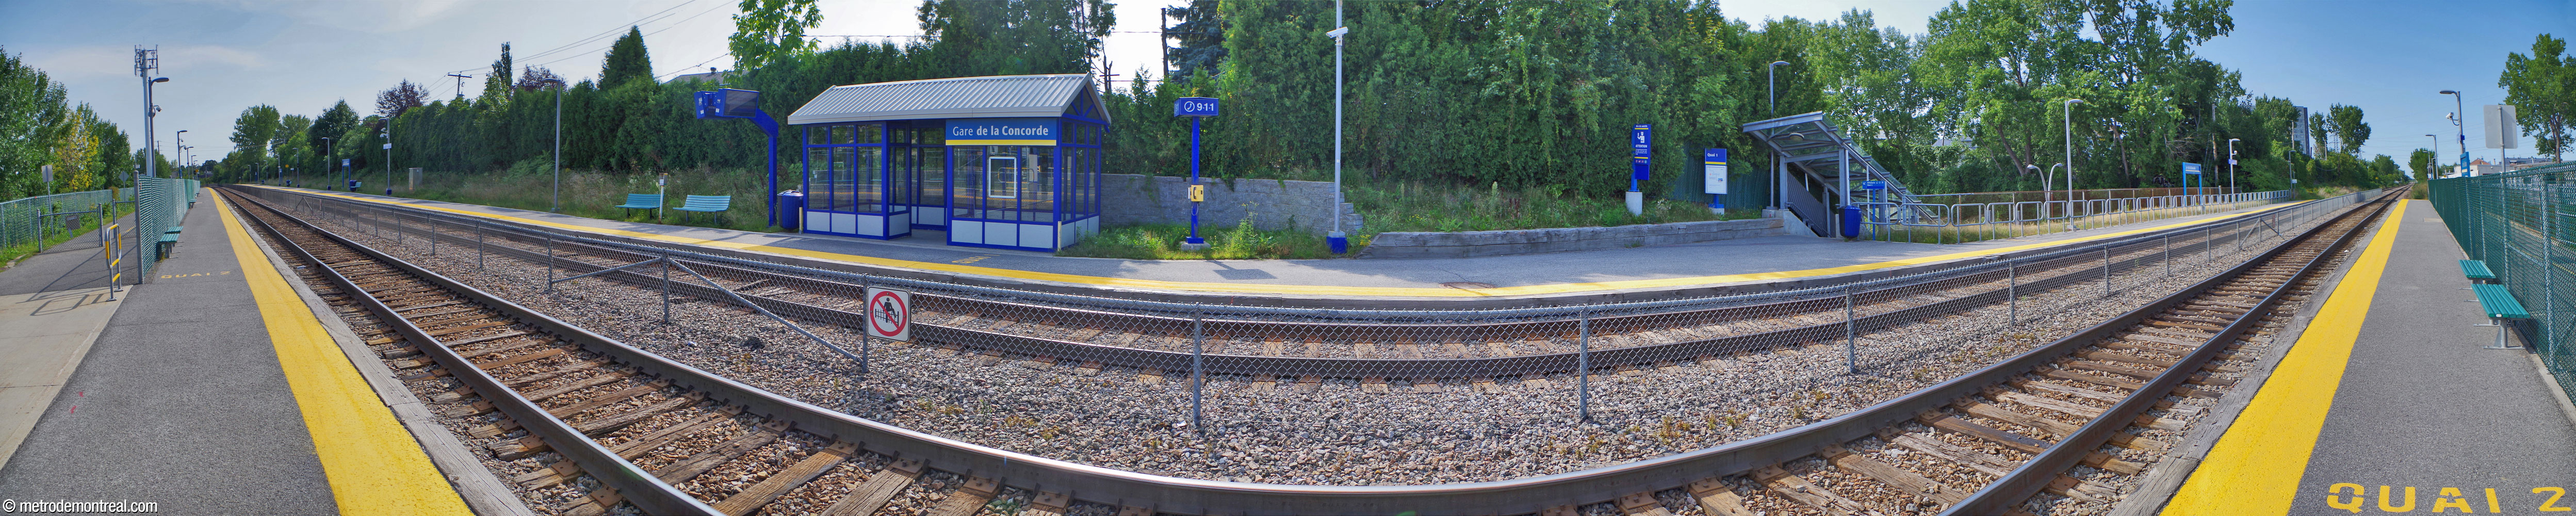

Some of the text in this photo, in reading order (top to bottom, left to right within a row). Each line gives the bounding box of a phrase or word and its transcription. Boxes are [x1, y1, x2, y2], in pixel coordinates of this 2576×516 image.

[953, 125, 1048, 136] Gare de la Concorde
[2326, 482, 2571, 513] QUAI 2
